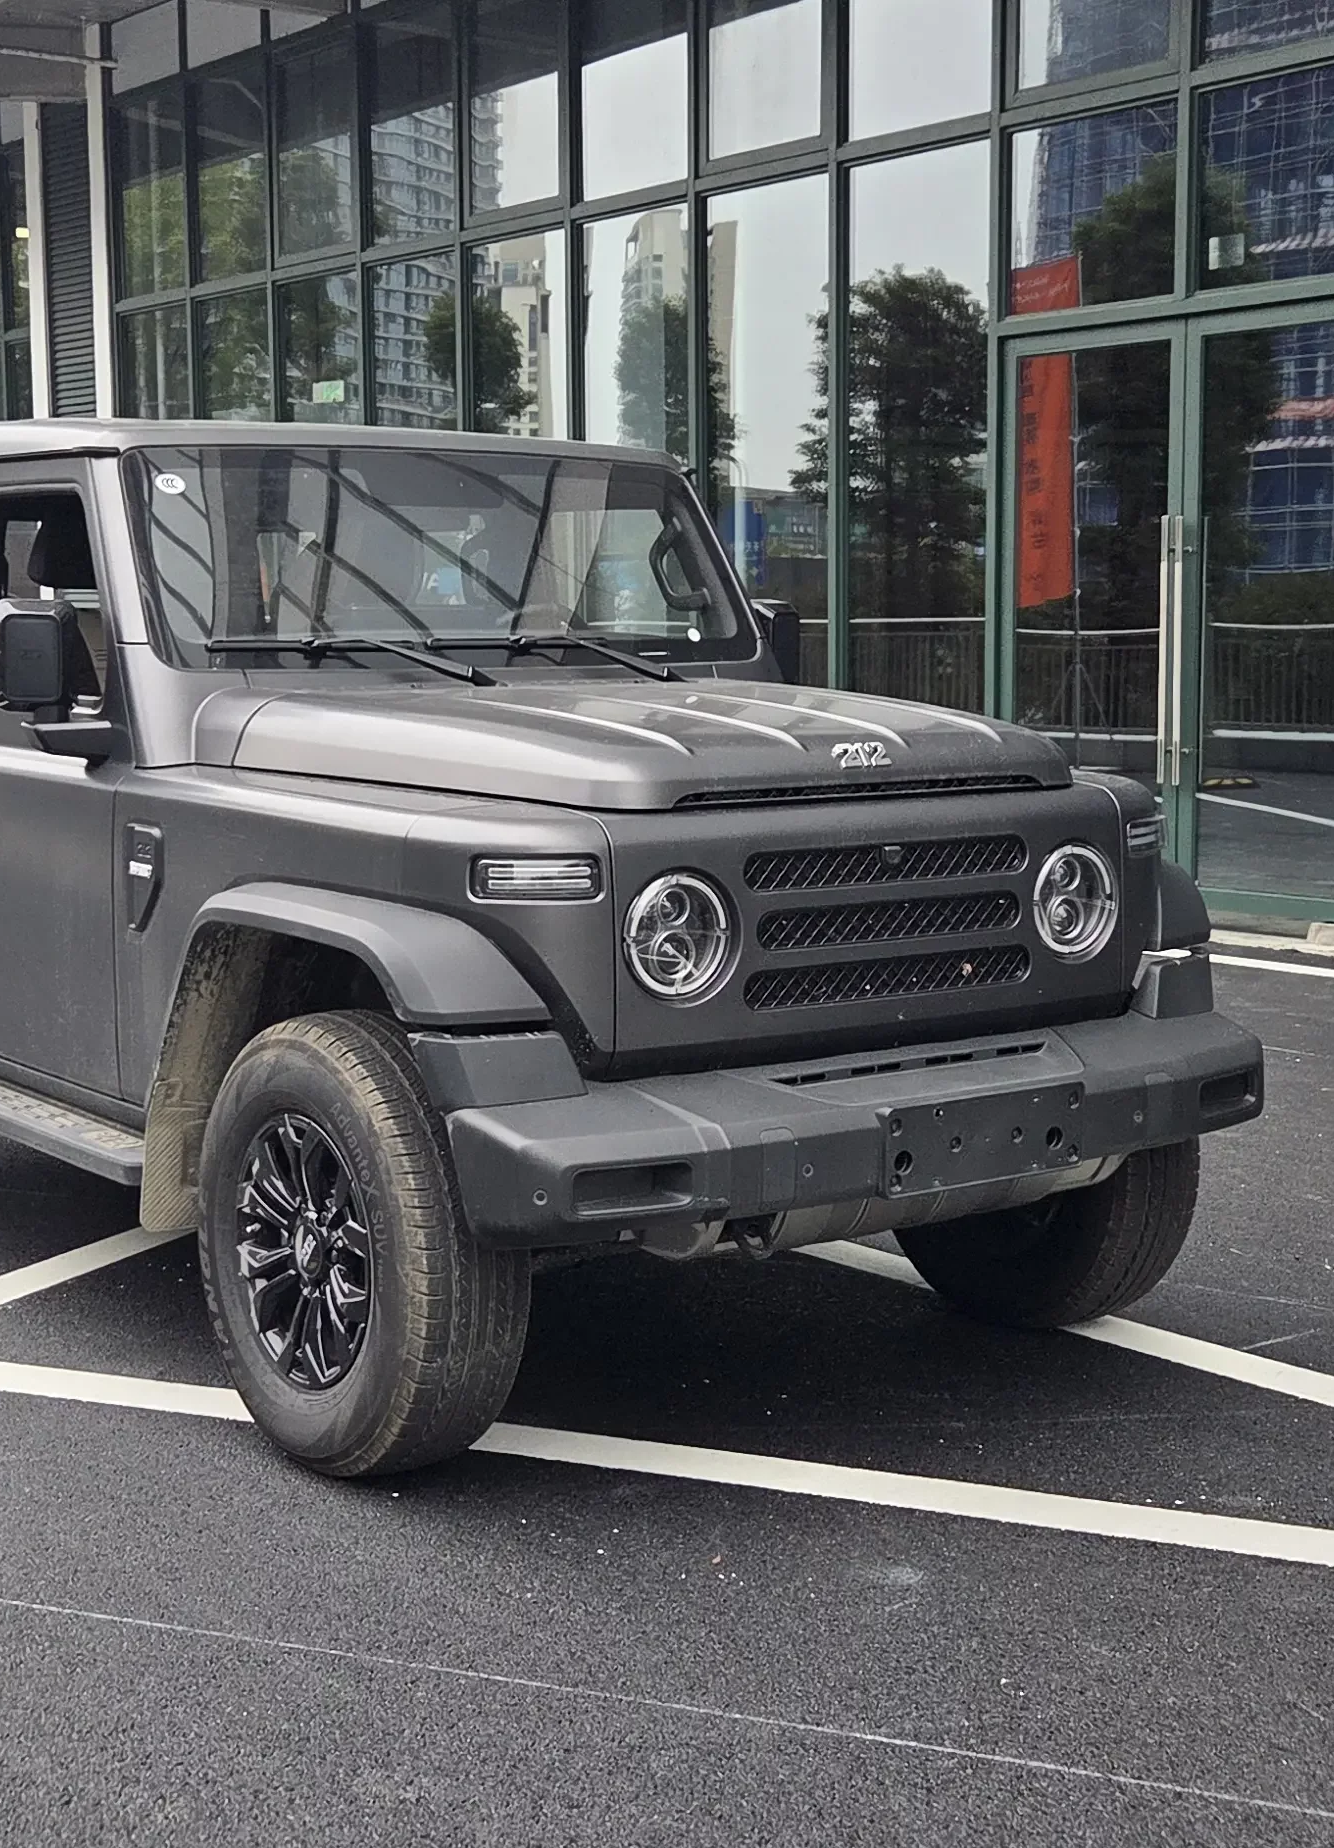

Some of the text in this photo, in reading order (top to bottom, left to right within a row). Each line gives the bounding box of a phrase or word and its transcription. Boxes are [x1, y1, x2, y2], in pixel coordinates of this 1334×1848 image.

[831, 741, 893, 769] 212
[329, 1102, 388, 1257] AdvanteX SUV
